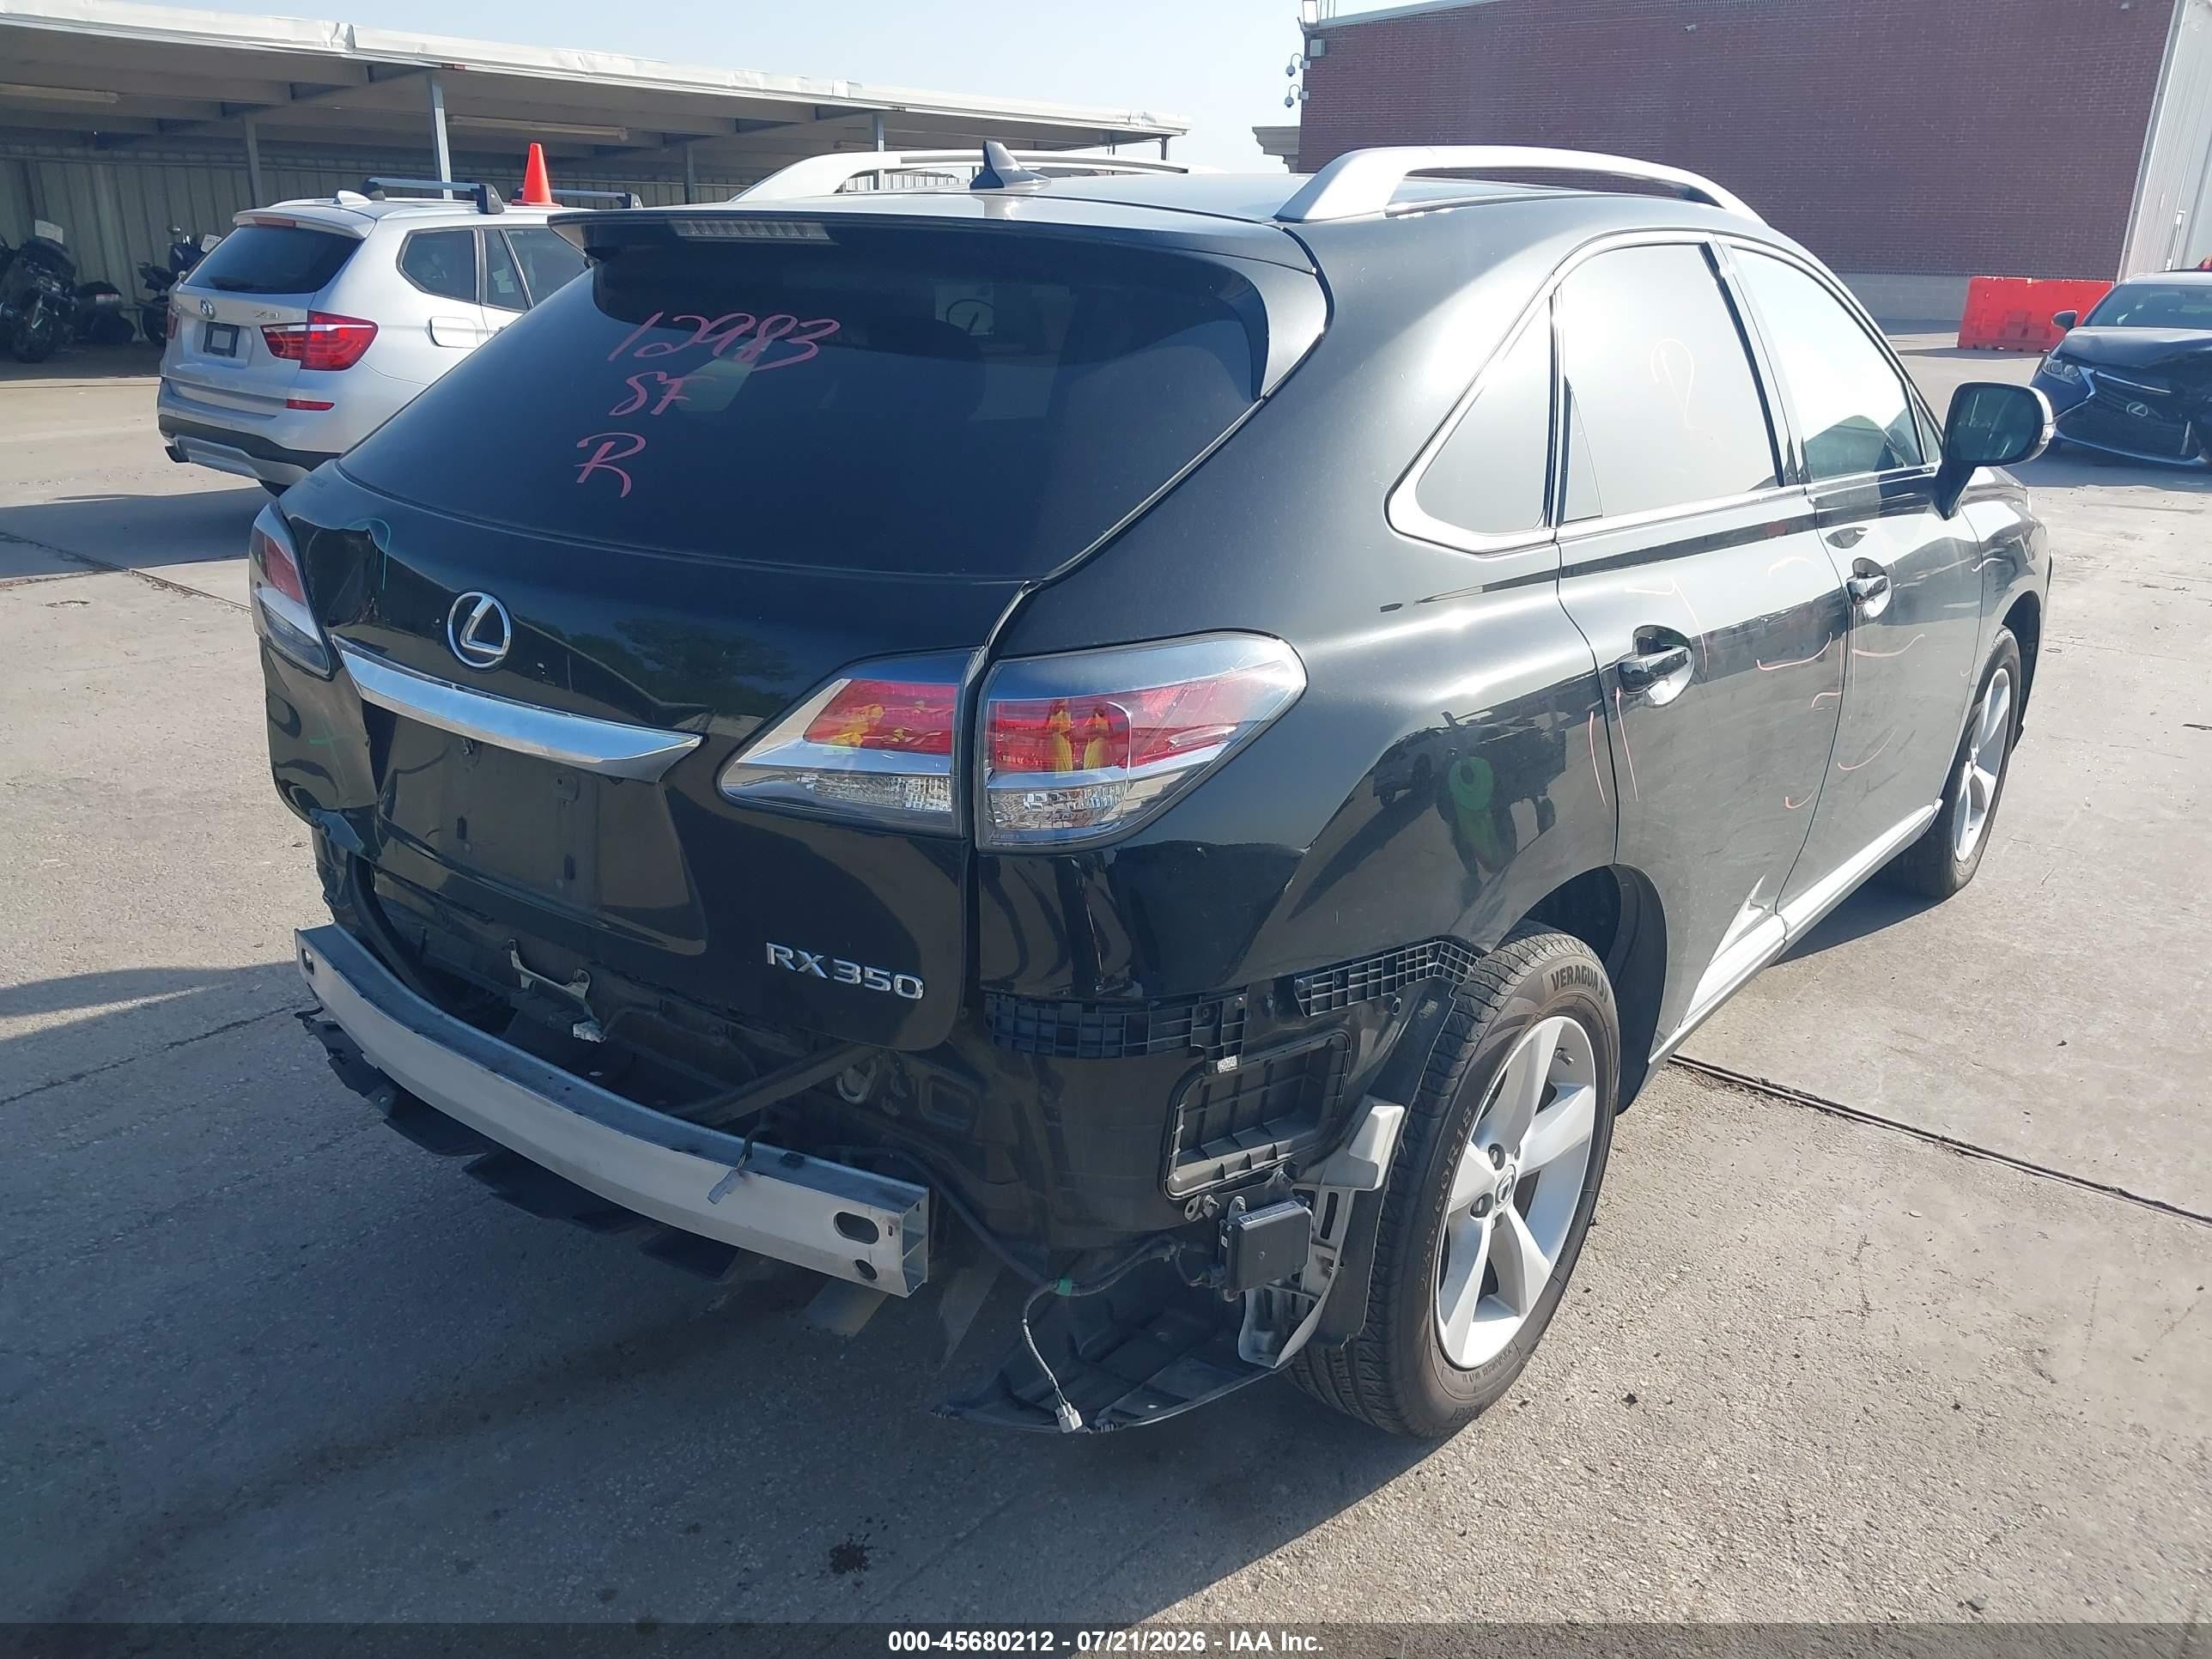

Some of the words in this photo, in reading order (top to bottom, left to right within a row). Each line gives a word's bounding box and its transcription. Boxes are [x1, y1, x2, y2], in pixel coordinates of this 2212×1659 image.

[607, 311, 841, 372] 12983
[574, 432, 647, 498] R
[766, 942, 828, 979] RX
[833, 958, 924, 1000] 350
